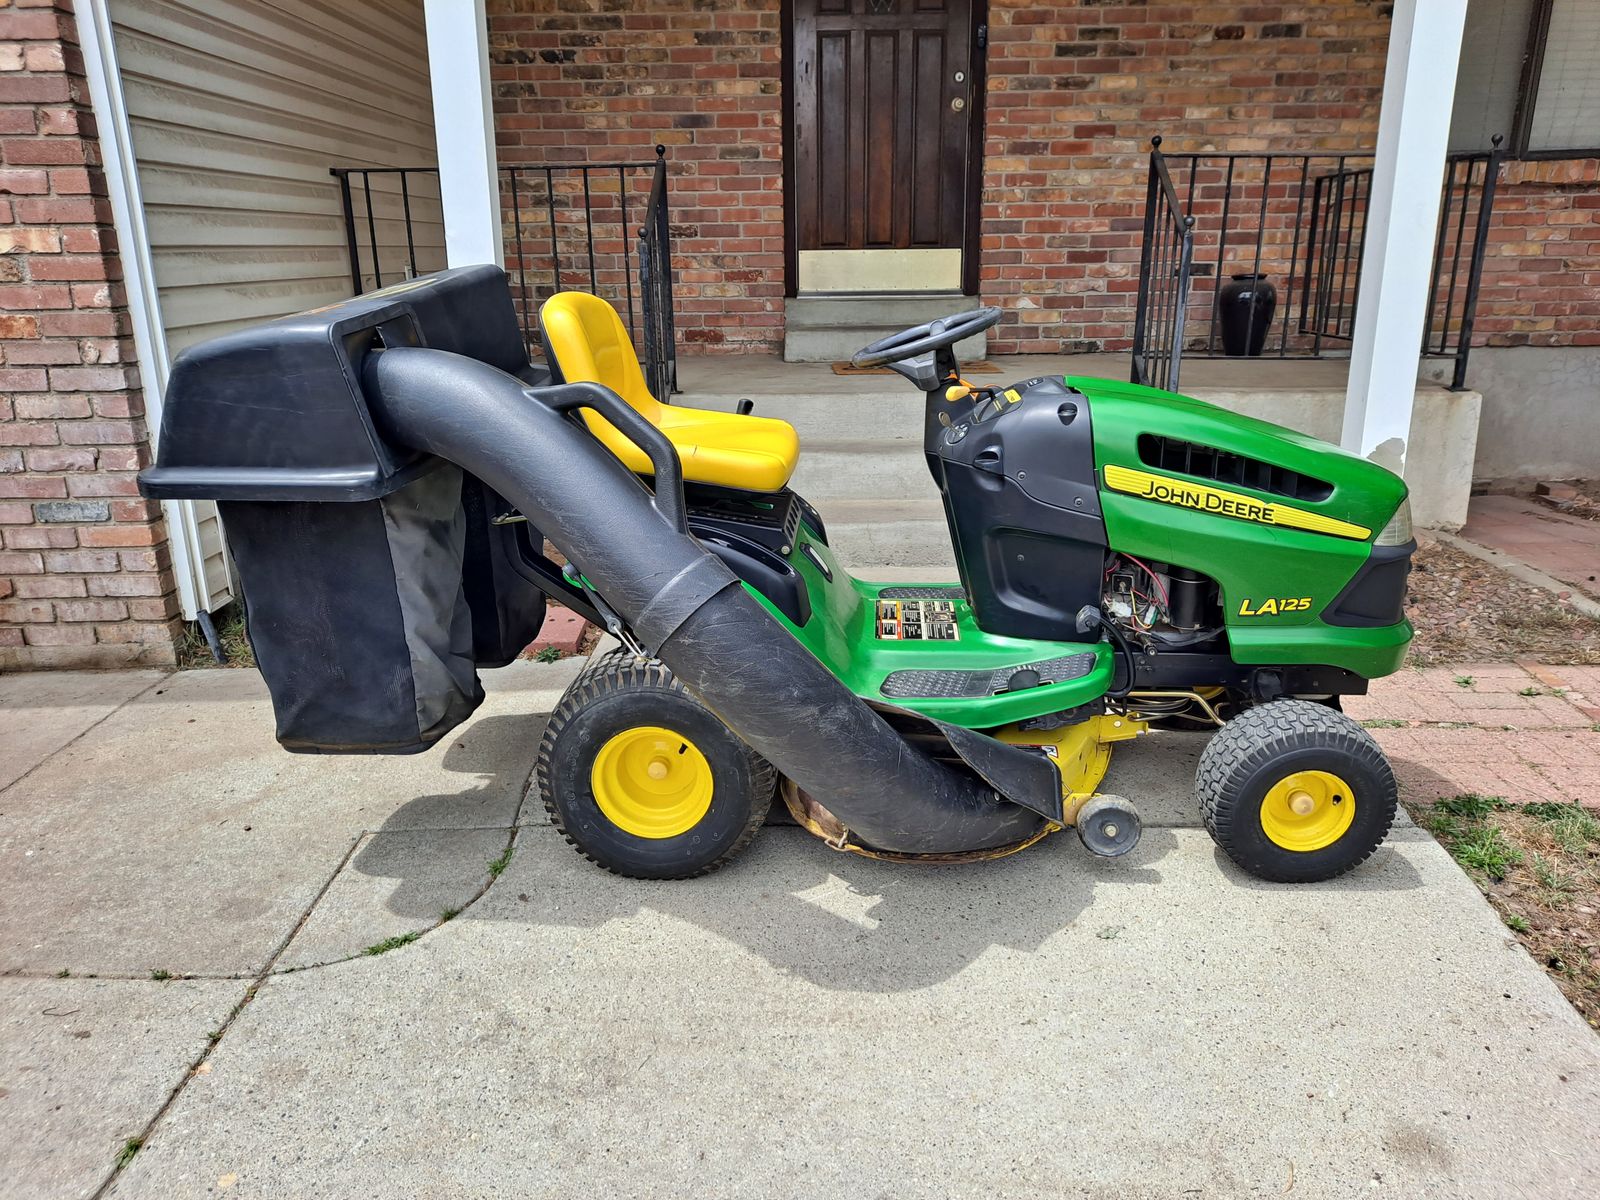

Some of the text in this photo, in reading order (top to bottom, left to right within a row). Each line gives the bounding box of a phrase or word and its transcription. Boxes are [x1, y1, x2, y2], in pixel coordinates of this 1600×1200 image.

[1142, 481, 1275, 521] JOHN DEERE
[1239, 597, 1312, 616] LA125
